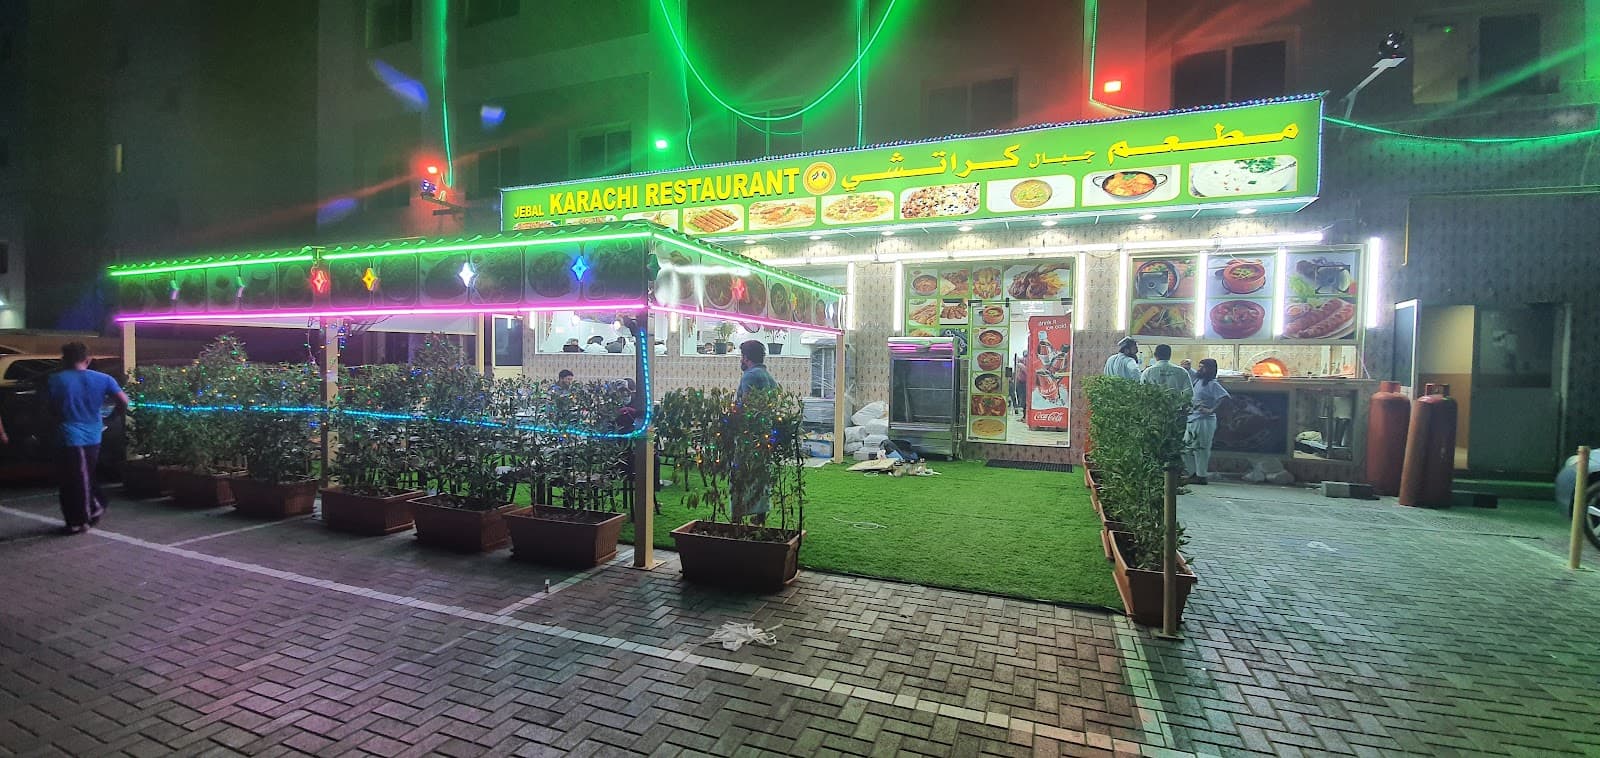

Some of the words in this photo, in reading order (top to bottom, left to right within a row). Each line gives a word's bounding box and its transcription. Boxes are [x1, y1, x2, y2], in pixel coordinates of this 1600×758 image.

[1028, 150, 1096, 169] جبال
[1108, 123, 1299, 166] مطعم
[841, 144, 1021, 192] كراتشي
[513, 204, 545, 219] JEBAL
[549, 184, 638, 216] KARACHI
[645, 167, 800, 208] RESTAURANT
